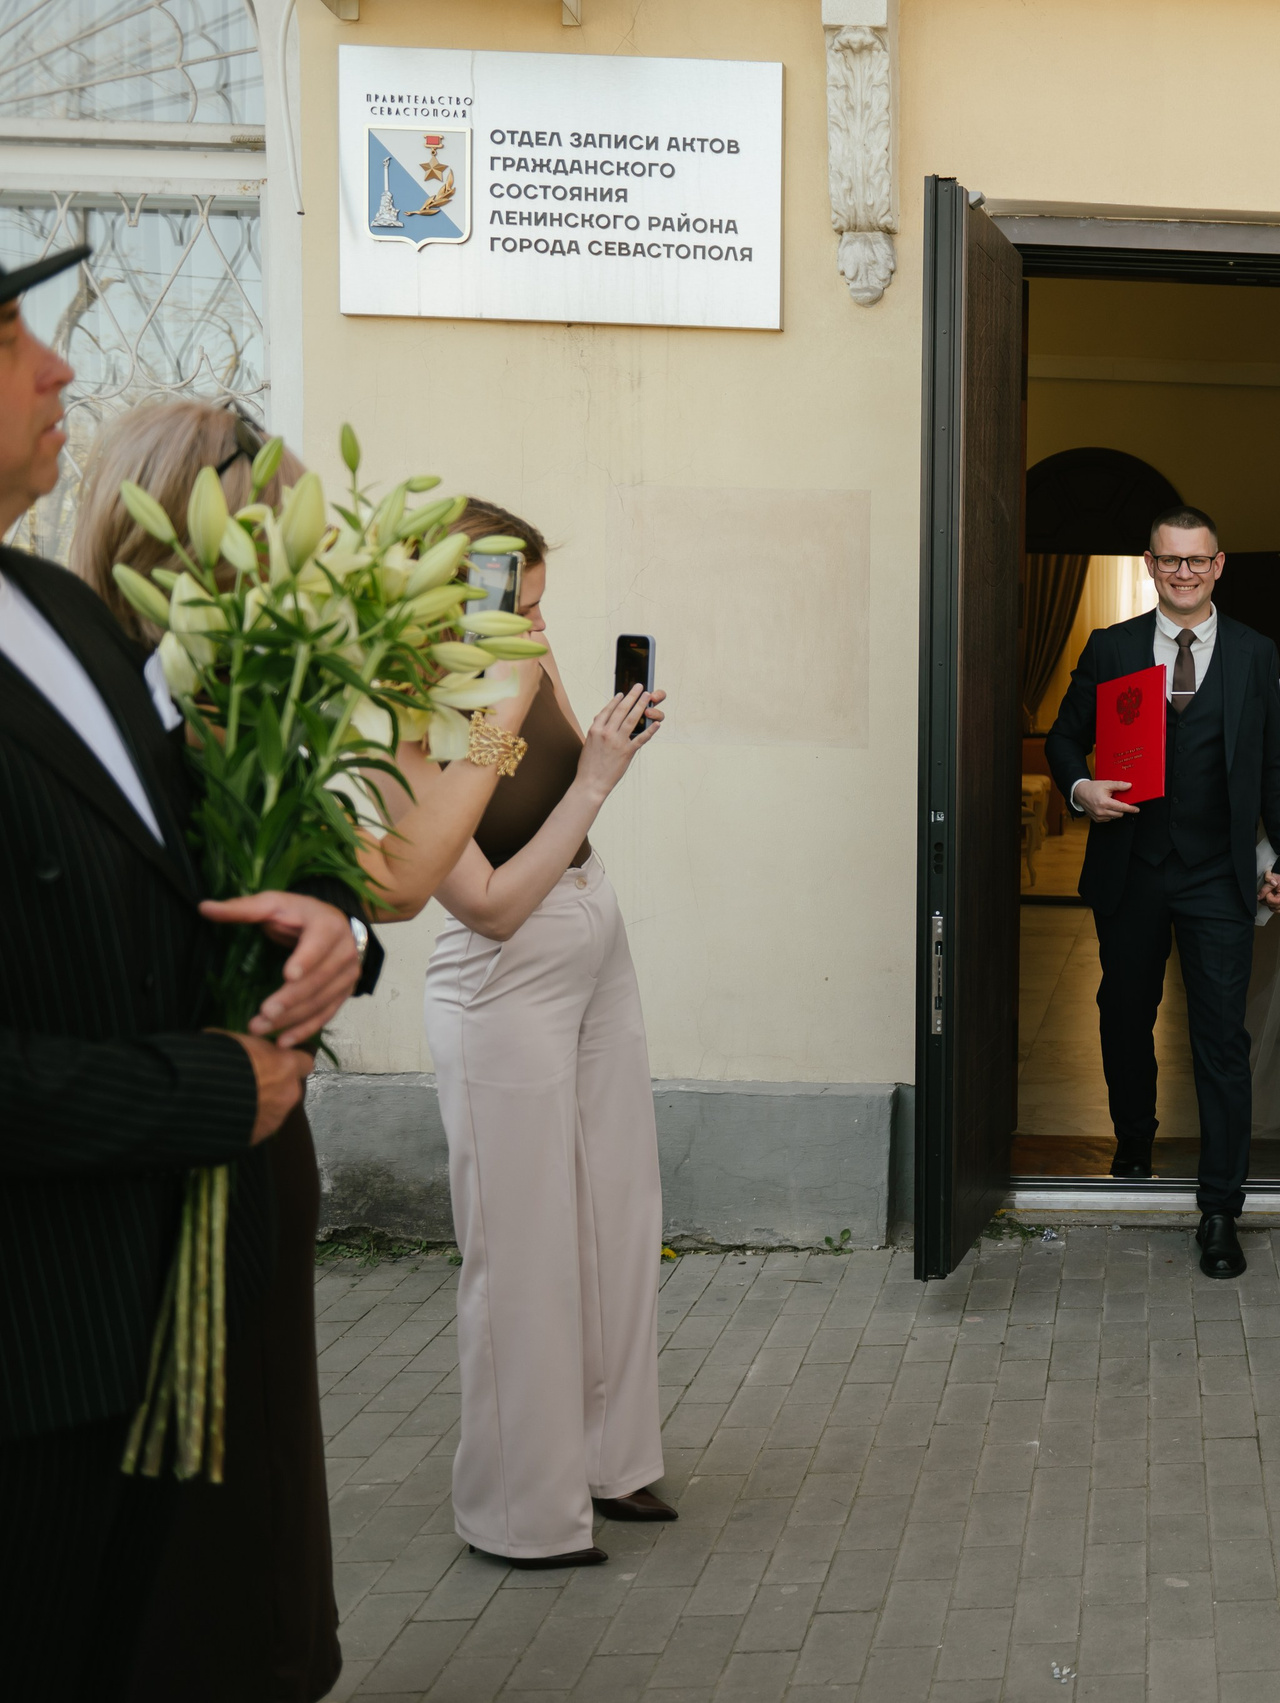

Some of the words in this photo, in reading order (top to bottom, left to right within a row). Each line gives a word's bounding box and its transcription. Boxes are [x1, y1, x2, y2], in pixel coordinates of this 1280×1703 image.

[366, 93, 473, 106] ПРАВИТЕЛЬСТВО
[370, 106, 467, 118] СЕВАСТОПОЛЯ
[490, 129, 563, 148] ОТДЕЛ
[569, 132, 659, 151] ЗАПИСИ
[667, 137, 741, 155] АКТОВ
[490, 156, 676, 178] ГРАЖДАНСКОГО
[489, 182, 628, 203] СОСТОЯНИЯ
[489, 209, 641, 230] ЛЕНИНСКОГО
[648, 213, 739, 235] РАЙОНА
[490, 237, 581, 257] ГОРОДА
[587, 240, 753, 262] СЕВАСТОПОЛЯ
